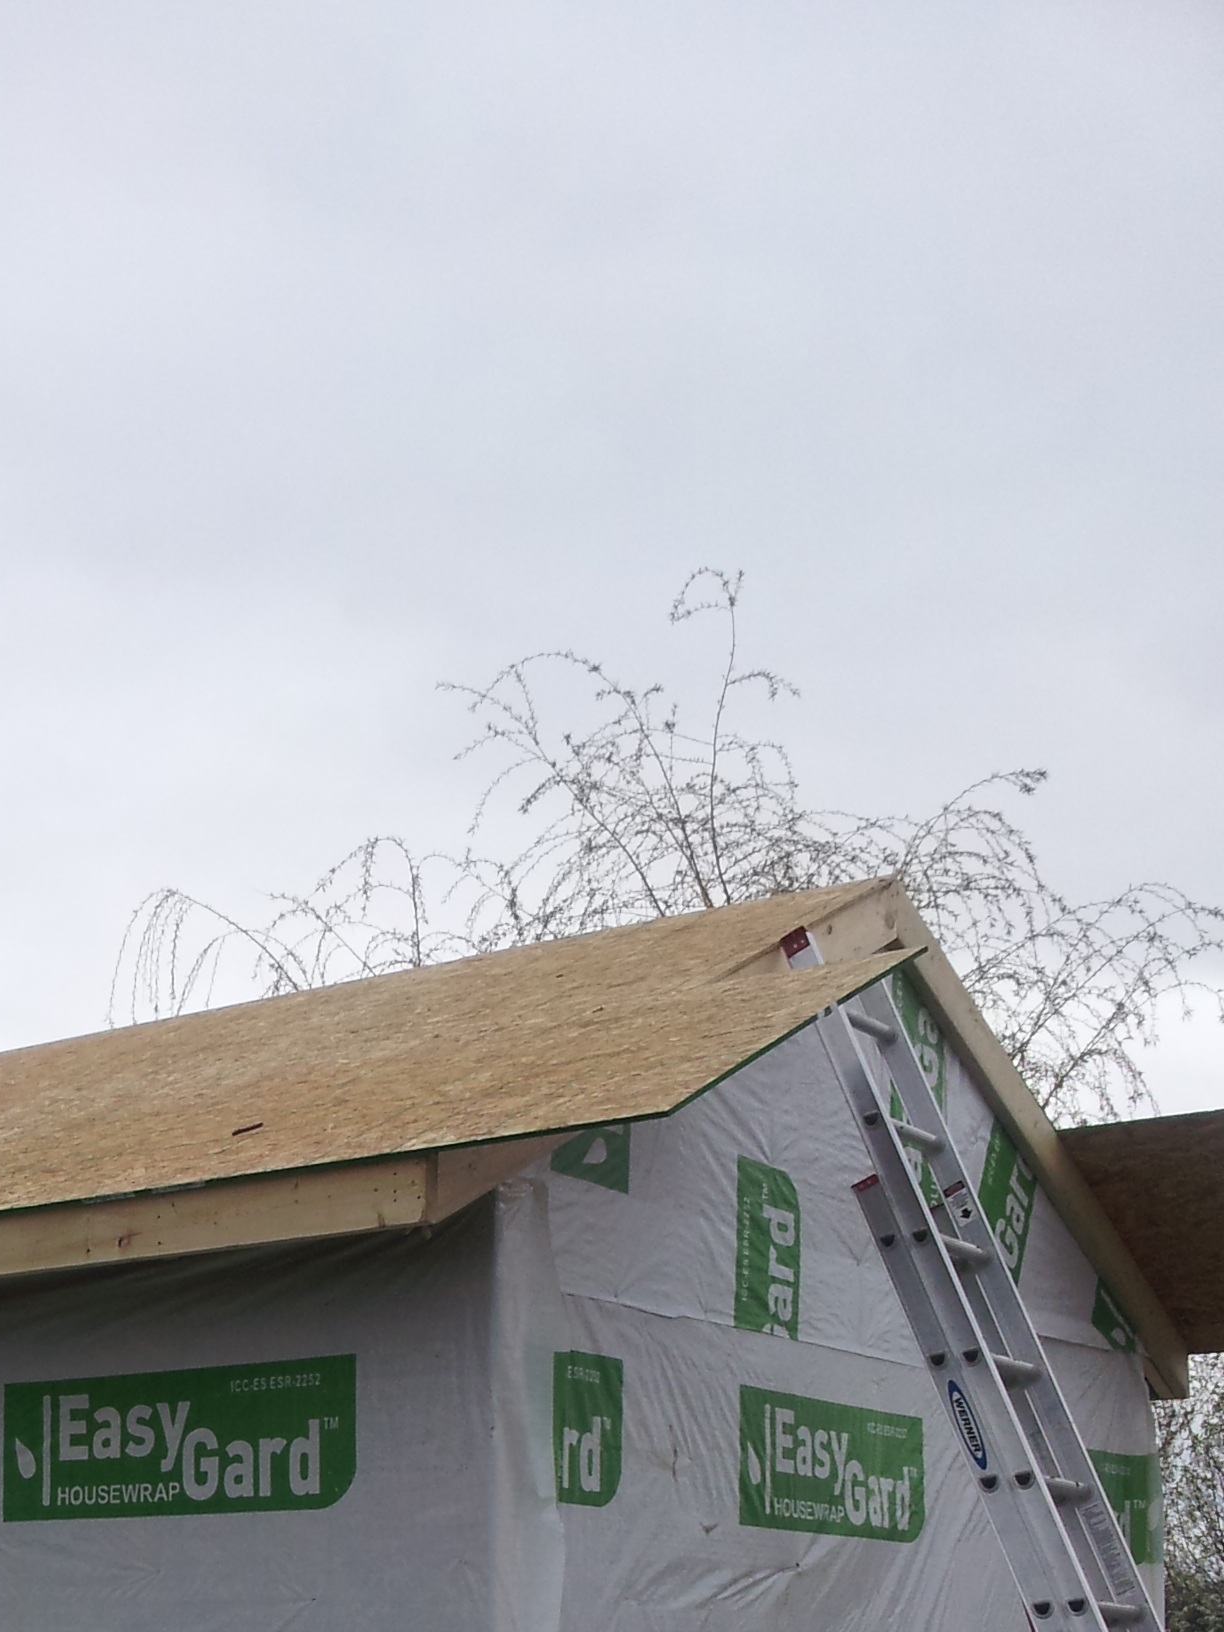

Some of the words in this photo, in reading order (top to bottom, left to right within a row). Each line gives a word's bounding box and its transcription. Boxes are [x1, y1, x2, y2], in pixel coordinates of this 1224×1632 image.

[953, 1397, 982, 1453] WERNER
[56, 1482, 180, 1506] HOUSEWRAP
[774, 1498, 845, 1523] HOUSEWRAP
